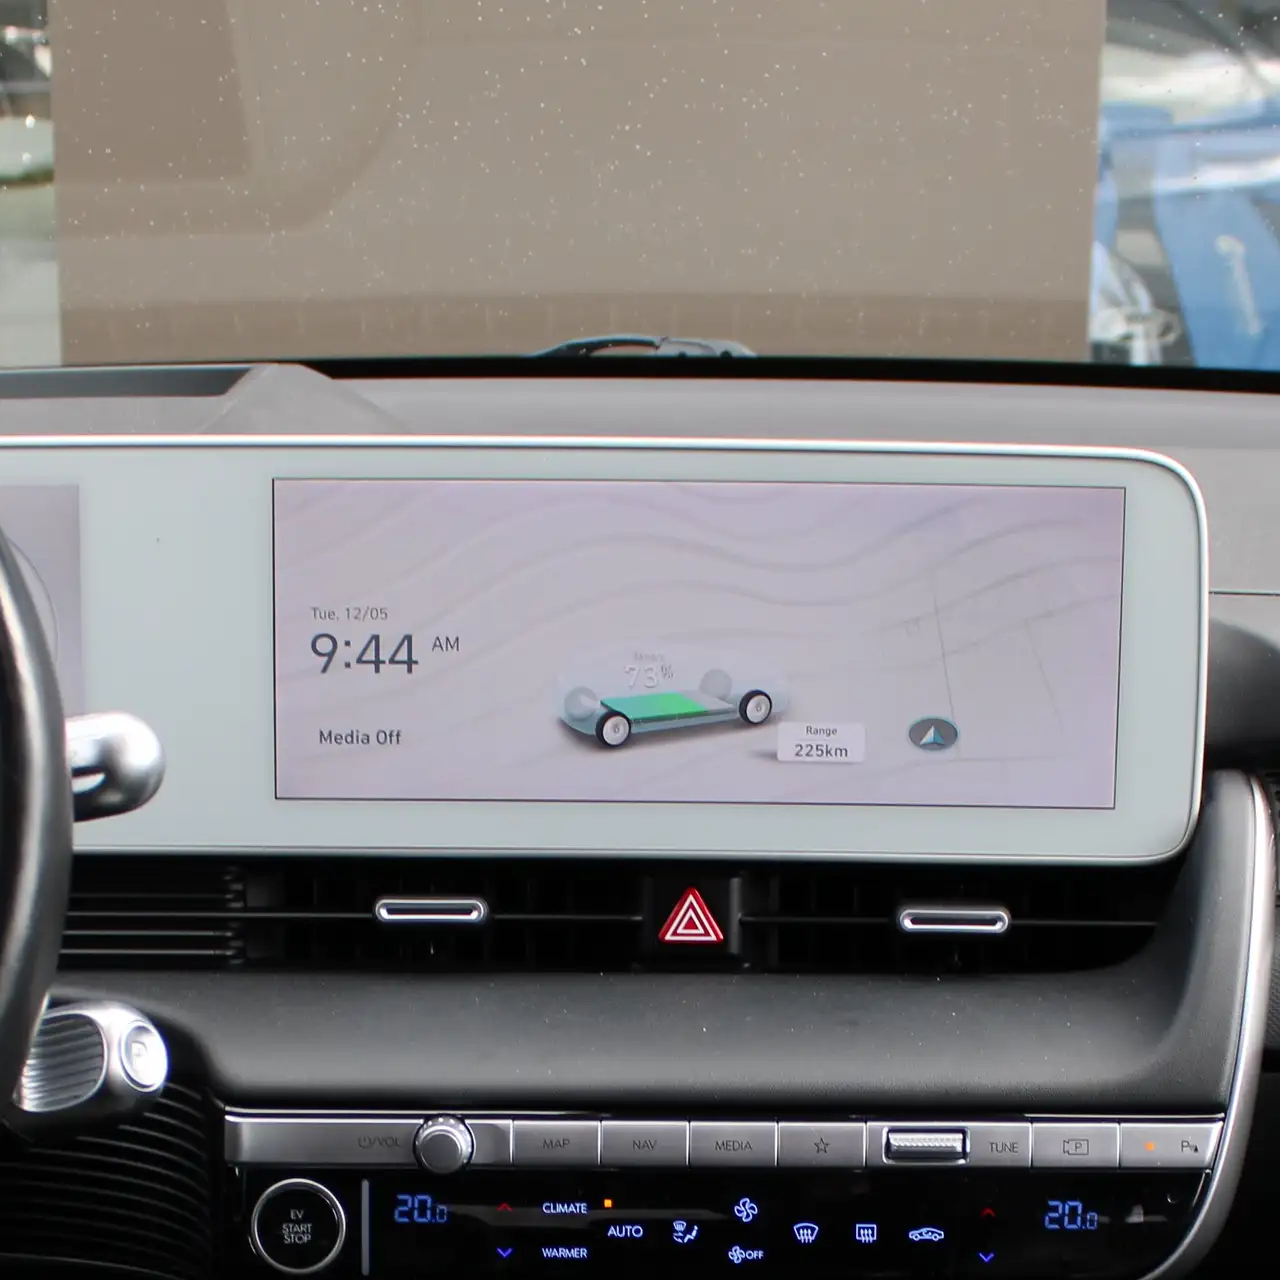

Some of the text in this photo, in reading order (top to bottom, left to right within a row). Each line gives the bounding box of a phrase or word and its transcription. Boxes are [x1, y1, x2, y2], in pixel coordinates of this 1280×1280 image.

[345, 607, 389, 622] 12/05
[311, 633, 460, 675] 9:44 AM
[319, 729, 402, 746] Media Off
[805, 726, 838, 737] Range
[794, 744, 848, 758] 225km
[543, 1137, 570, 1149] MAP
[632, 1138, 657, 1150] NAV
[715, 1138, 753, 1152] MEDIA
[989, 1140, 1019, 1153] TUNE
[542, 1202, 588, 1214] CLIMATE
[290, 1209, 303, 1220] EV
[282, 1223, 312, 1234] START
[608, 1225, 643, 1238] AUTO
[283, 1234, 311, 1245] STOP
[542, 1247, 588, 1259] WARMER
[746, 1250, 763, 1260] OFF
